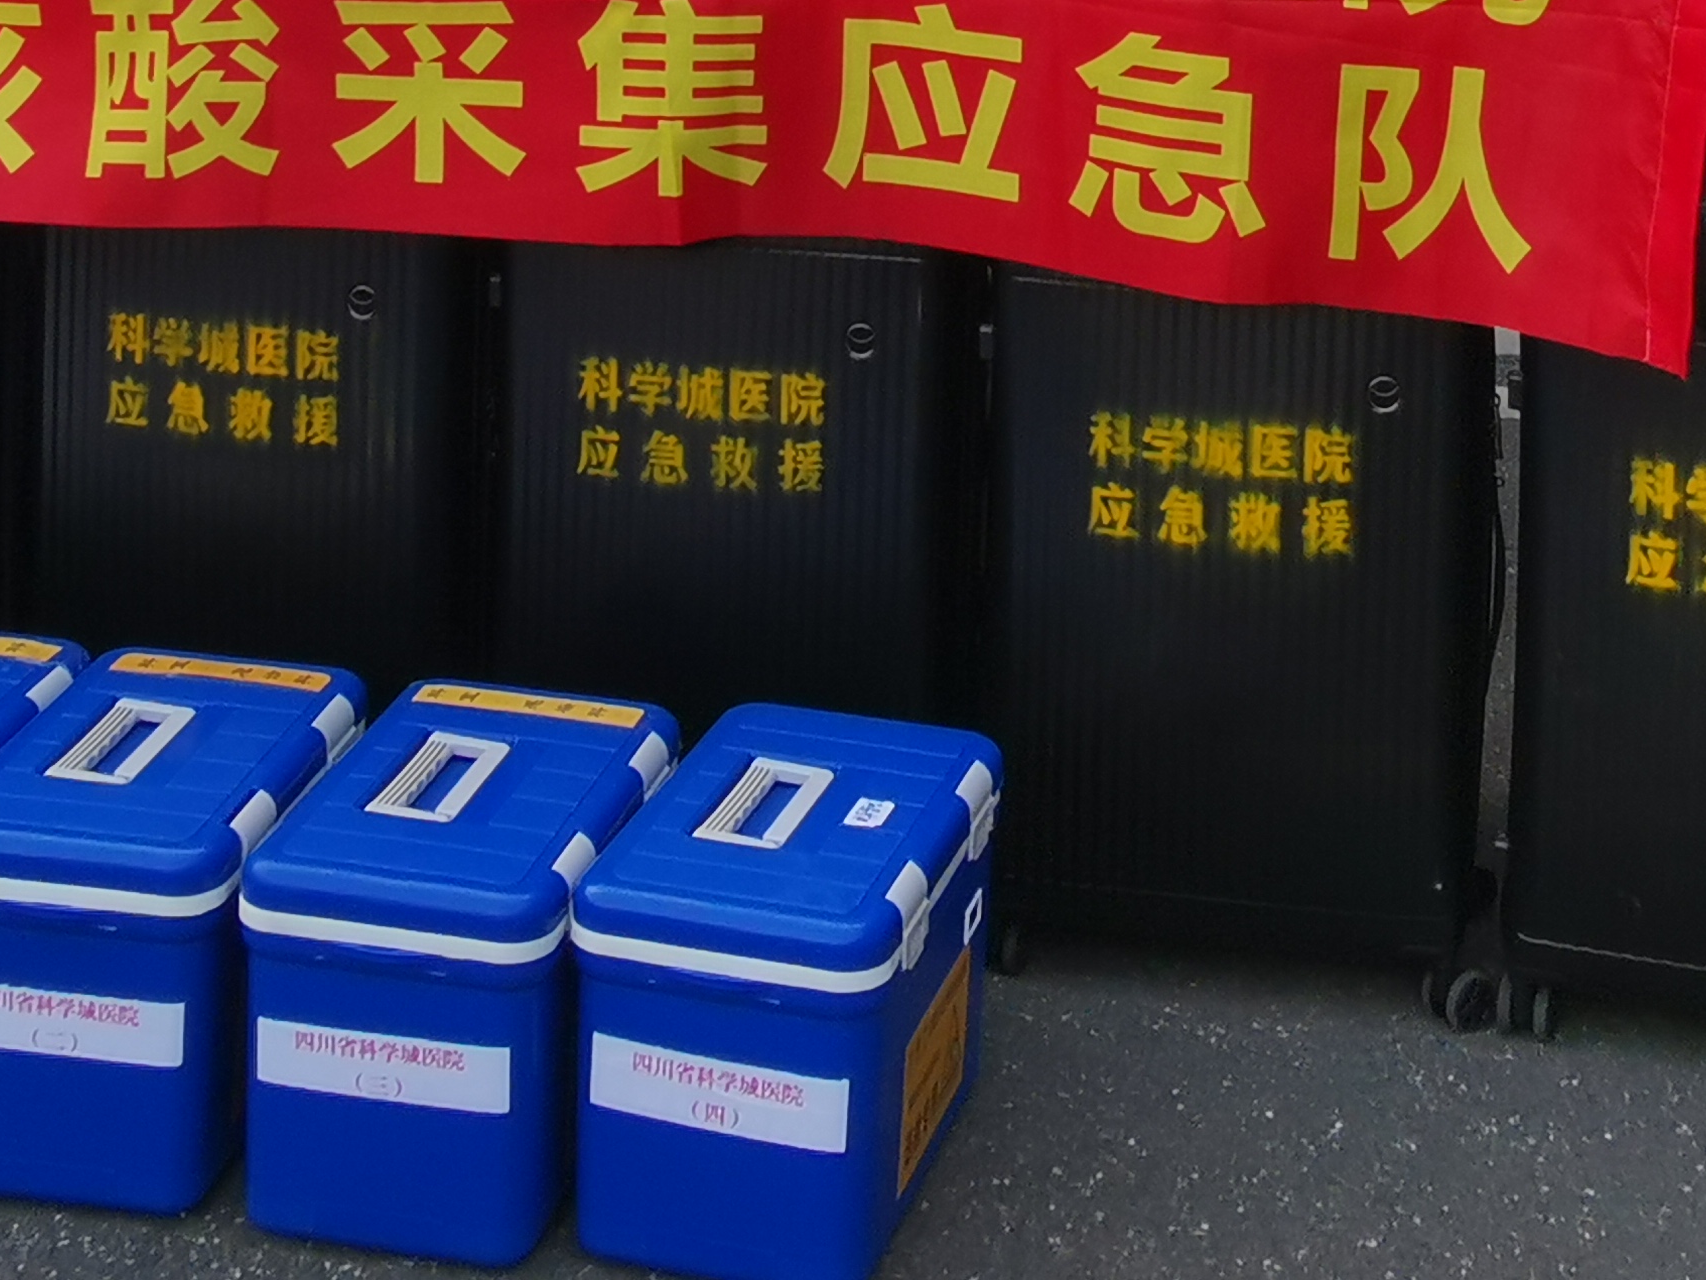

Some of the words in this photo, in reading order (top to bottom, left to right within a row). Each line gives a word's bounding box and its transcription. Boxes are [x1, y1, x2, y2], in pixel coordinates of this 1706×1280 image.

[110, 314, 338, 379] 科学城医院
[110, 380, 337, 445] 应急救援
[581, 360, 824, 425] 科学城医院
[580, 428, 821, 488] 应急救援
[1092, 414, 1352, 483] 科学城医院
[1092, 483, 1351, 555] 应急救援
[295, 1031, 464, 1071] 四川省科学城医院
[632, 1052, 803, 1107] 四川省科学城医院
